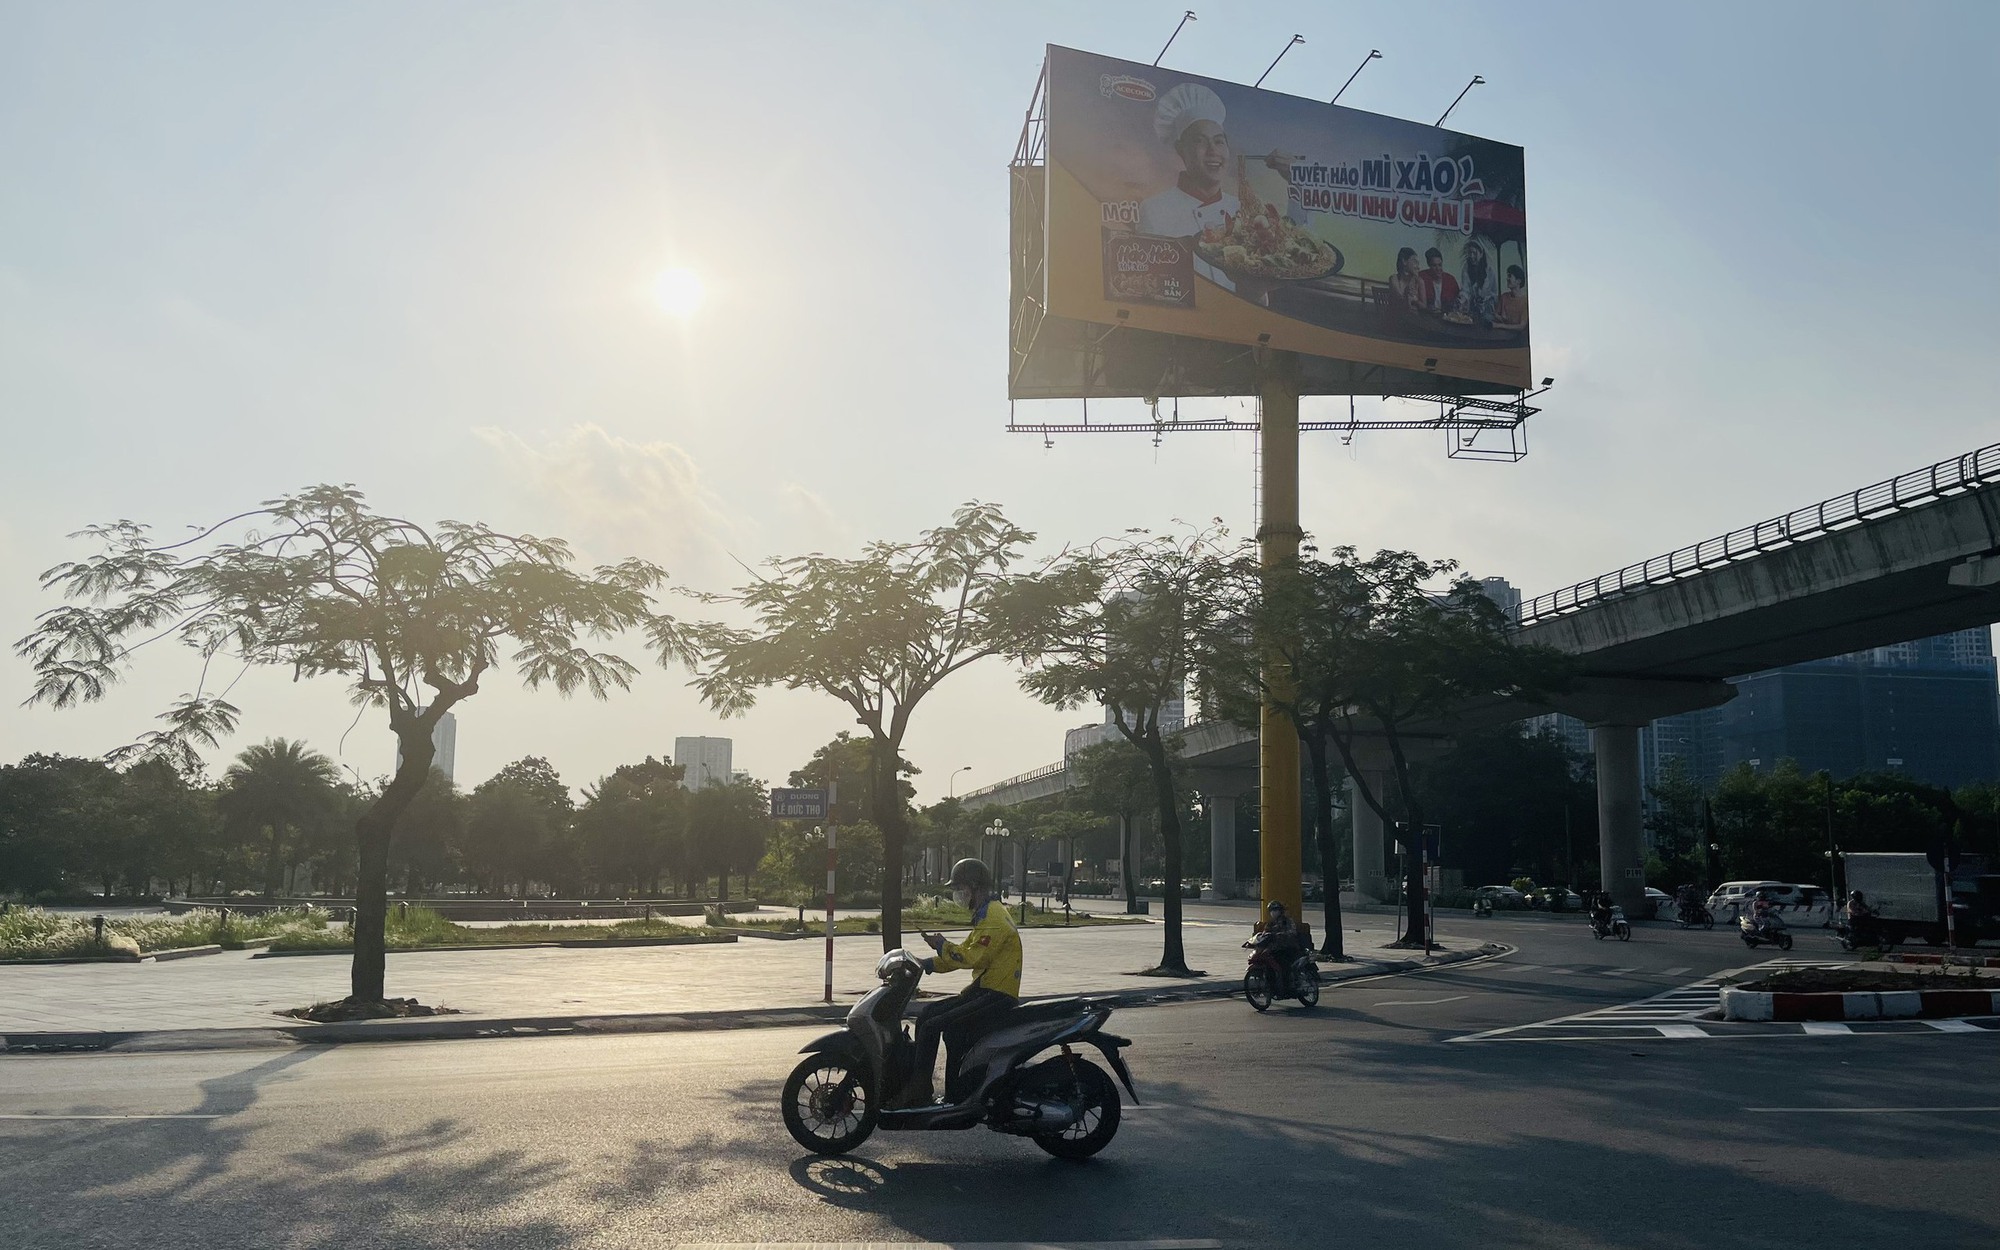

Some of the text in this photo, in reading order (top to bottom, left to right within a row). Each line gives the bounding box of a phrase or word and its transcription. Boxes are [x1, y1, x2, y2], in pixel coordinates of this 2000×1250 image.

[1291, 153, 1456, 193] TUYỆT HẢO MÌ XÀO
[1102, 201, 1140, 223] Mới
[1332, 191, 1358, 213] VUI
[1361, 195, 1399, 219] NHƯ
